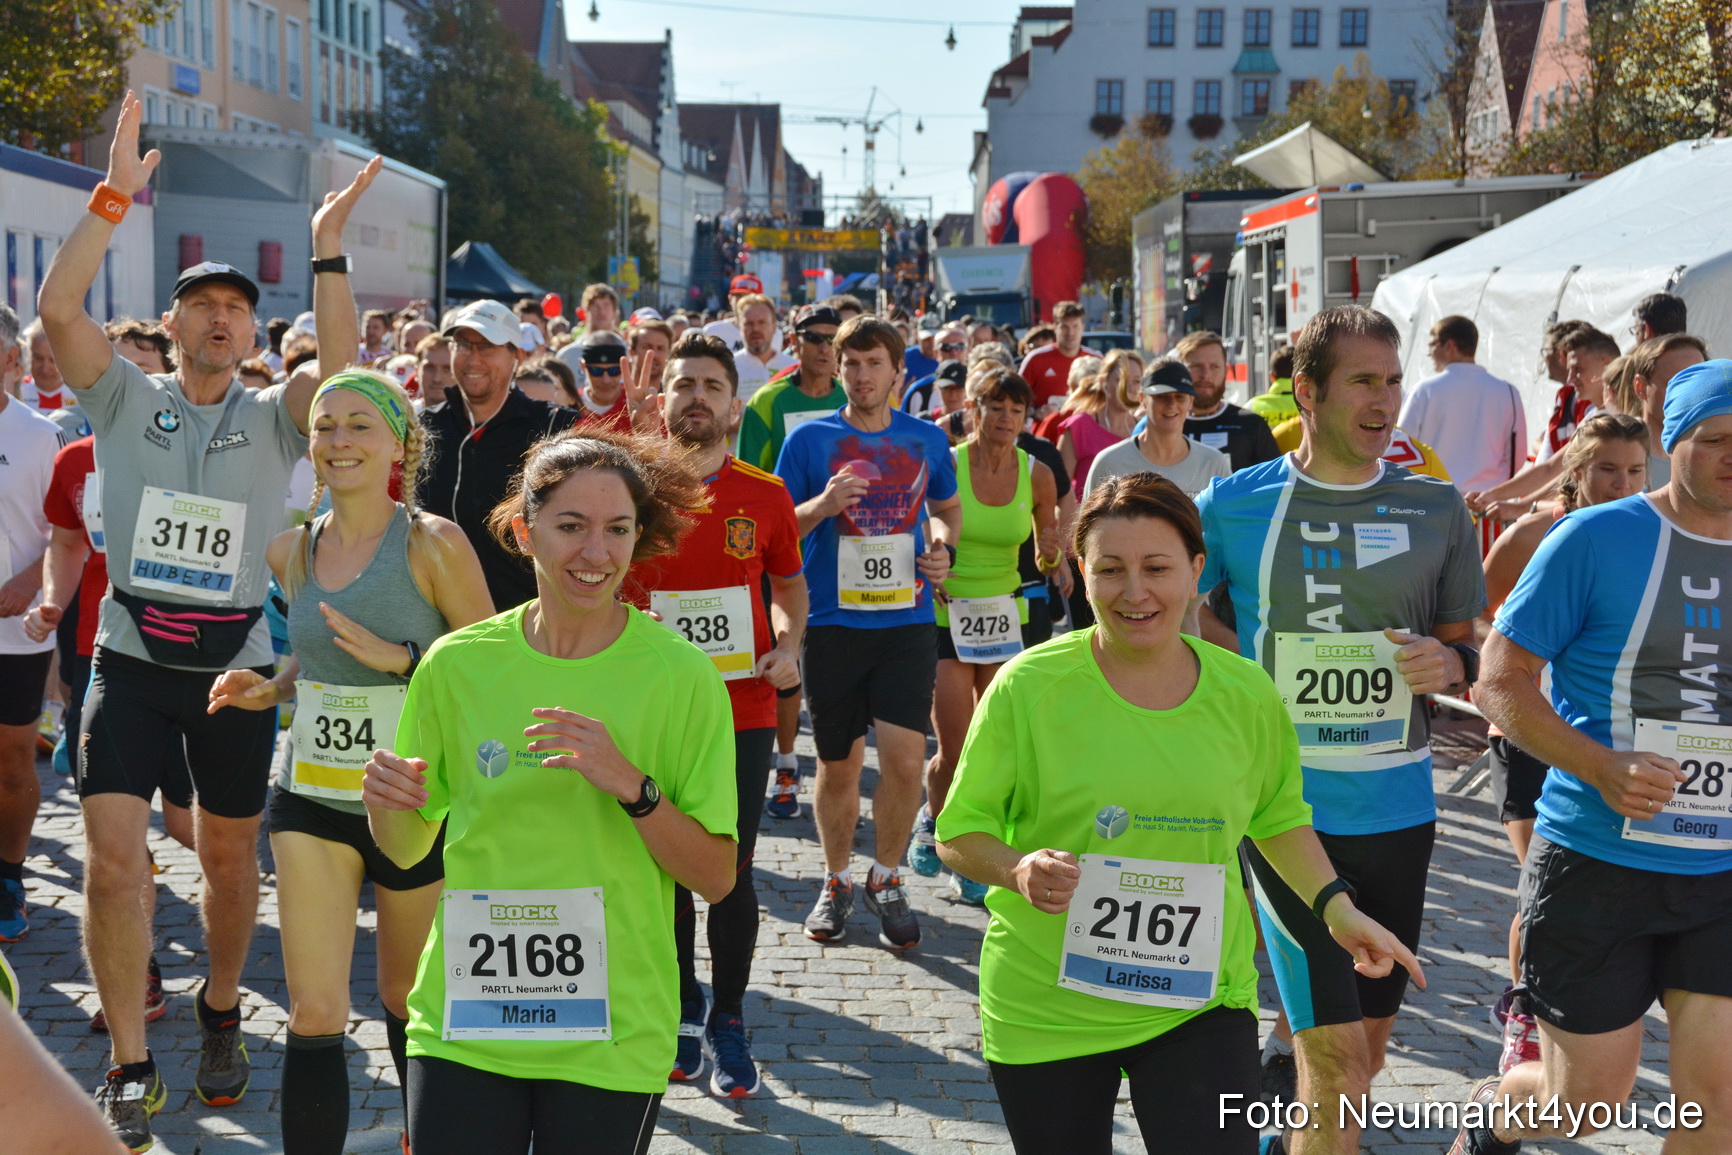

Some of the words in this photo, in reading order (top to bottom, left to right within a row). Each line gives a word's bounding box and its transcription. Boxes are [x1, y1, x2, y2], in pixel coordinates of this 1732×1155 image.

[208, 431, 248, 449] OCK
[173, 500, 221, 519] BOCK
[151, 517, 231, 557] 3118
[861, 542, 894, 552] BOCK
[155, 552, 178, 561] PARTL
[135, 560, 230, 589] HUBERT
[864, 557, 892, 580] 98
[1301, 522, 1343, 633] ATEC
[680, 597, 723, 609] BOCK
[861, 592, 896, 602] Manuel
[677, 615, 730, 643] 338
[960, 615, 1010, 636] 2478
[973, 647, 1002, 657] Renate
[1316, 645, 1376, 658] BOCK
[1679, 575, 1721, 723] MATEC
[1296, 668, 1393, 705] 2009
[322, 693, 369, 708] BOCK
[1335, 710, 1374, 718] Neumarkt
[315, 715, 376, 751] 334
[1318, 727, 1369, 742] Martin
[1677, 735, 1732, 751] BOCK
[312, 753, 333, 763] PARTL
[1673, 759, 1732, 797] 28
[1689, 803, 1726, 811] Neumarkt
[1134, 814, 1152, 822] Freie
[1153, 815, 1190, 824] katholische
[1673, 817, 1718, 838] Georg
[1119, 887, 1140, 895] inspired
[1120, 872, 1185, 892] BOCK
[490, 904, 559, 920] BOCK
[1074, 925, 1081, 934] C
[1089, 897, 1201, 947] 2167
[469, 933, 585, 977] 2168
[1097, 945, 1129, 958] PARTL
[1131, 950, 1176, 963] Neumarkt
[456, 967, 461, 976] C
[1105, 966, 1172, 991] Larissa
[482, 985, 514, 994] PARTL
[516, 984, 563, 993] Neumarkt
[502, 1004, 556, 1024] Maria
